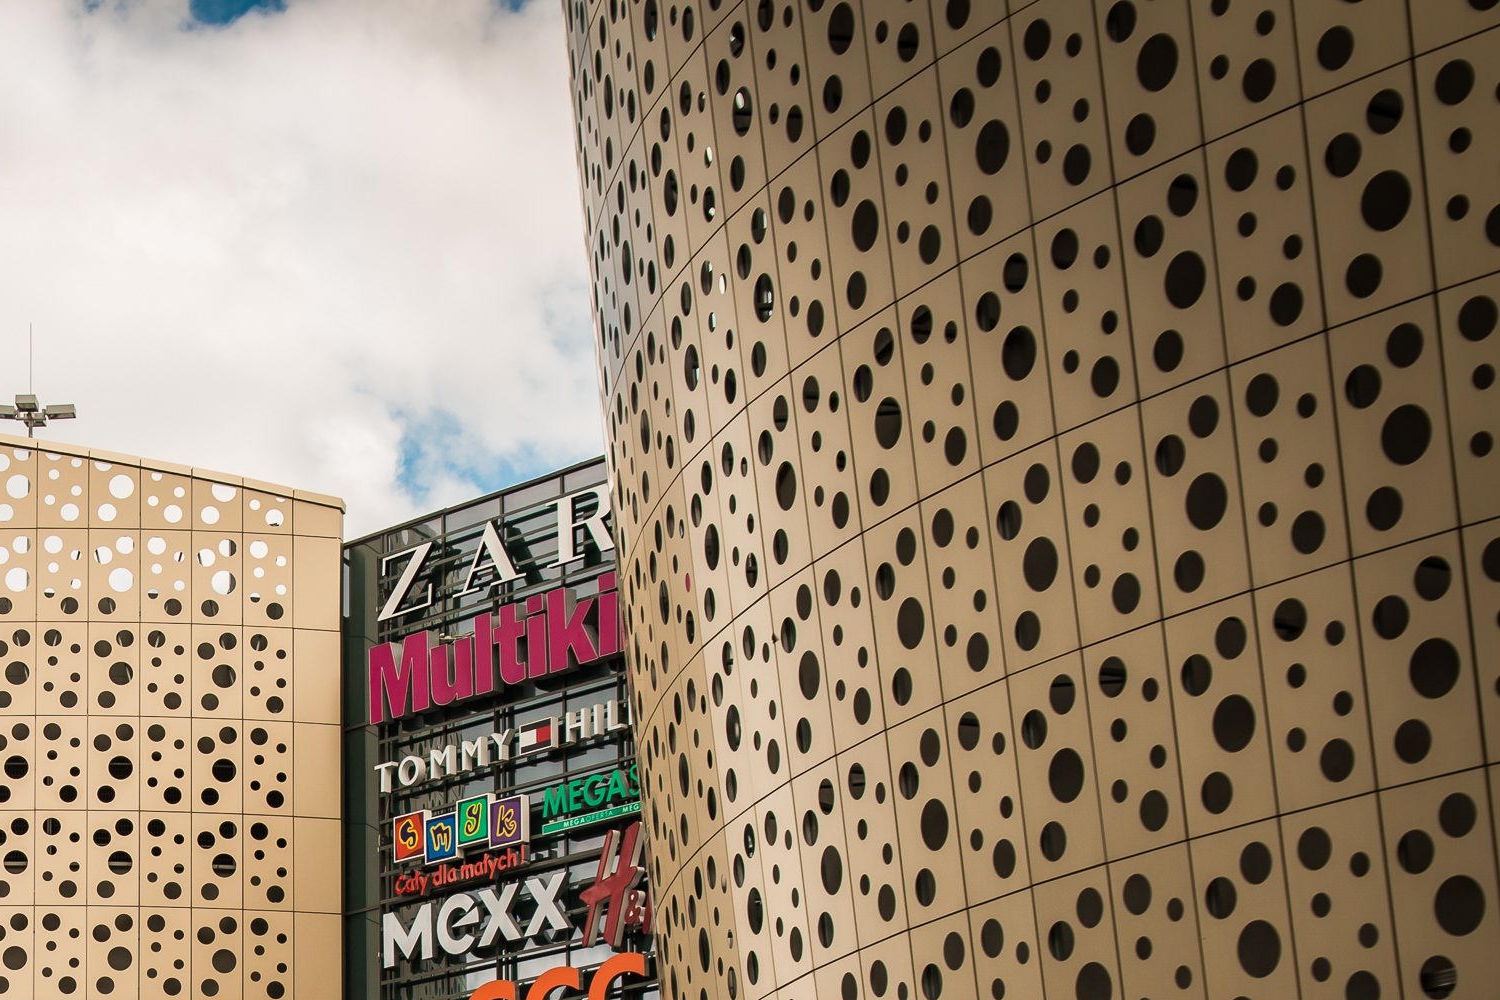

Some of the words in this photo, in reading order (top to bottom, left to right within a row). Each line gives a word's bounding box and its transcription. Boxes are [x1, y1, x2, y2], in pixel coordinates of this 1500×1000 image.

[377, 484, 615, 622] ZAR
[368, 570, 628, 726] Multiki
[374, 728, 513, 794] TOMMY
[565, 694, 633, 743] HIL
[541, 763, 641, 819] MEGAS
[621, 802, 641, 815] MEG
[432, 863, 457, 887] dla
[579, 820, 651, 949] H&
